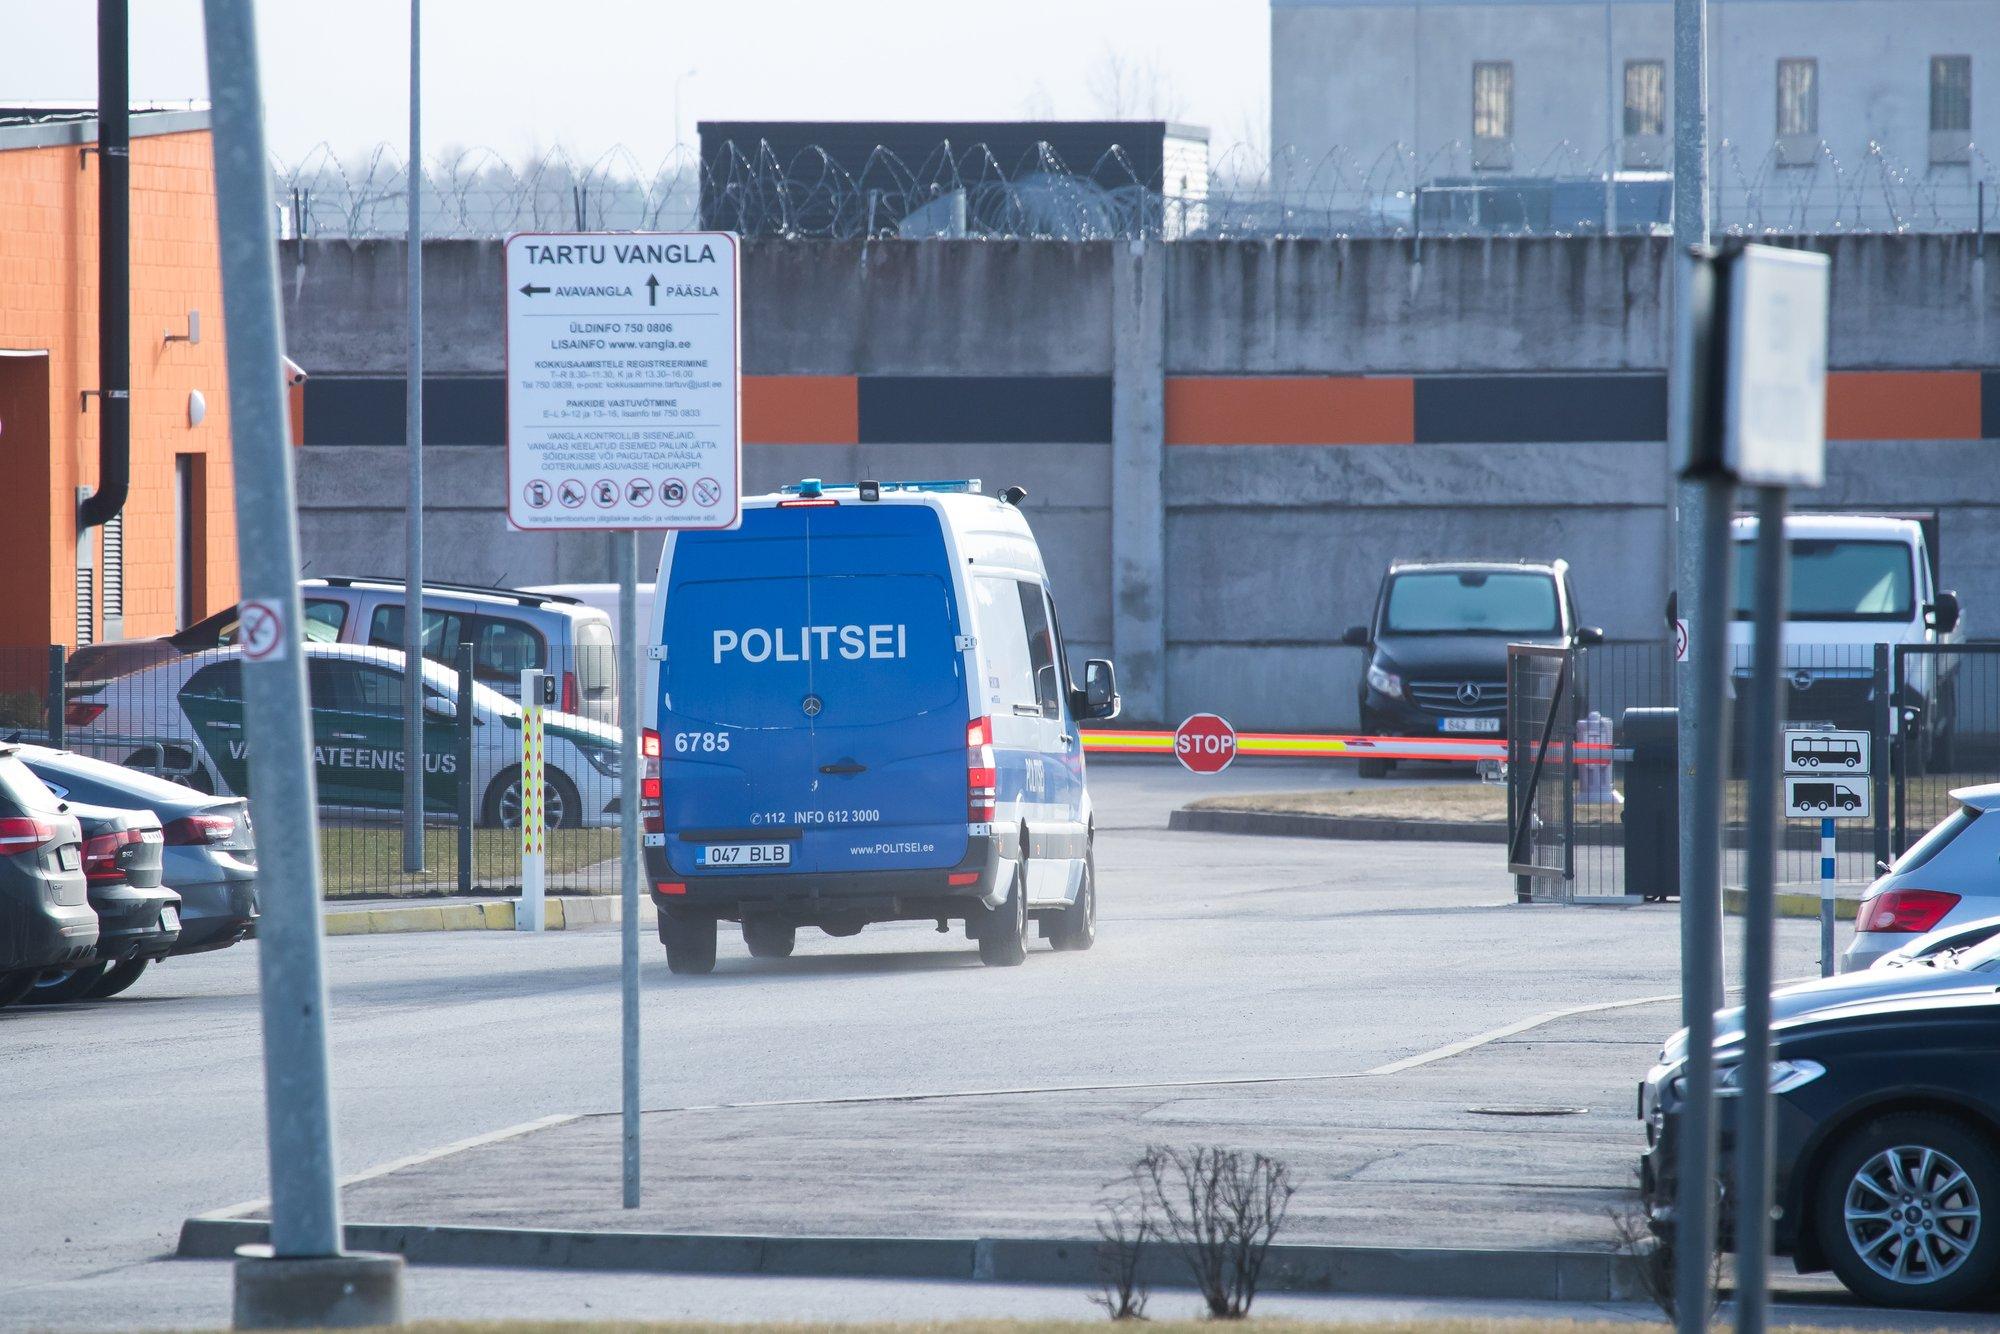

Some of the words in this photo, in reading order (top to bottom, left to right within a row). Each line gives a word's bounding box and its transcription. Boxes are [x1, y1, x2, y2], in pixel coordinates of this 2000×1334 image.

[525, 244, 605, 264] TARTU
[614, 243, 716, 264] VANGLA
[555, 286, 633, 297] AVAVANGLA
[666, 284, 719, 297] PÄÄSLA
[569, 321, 621, 333] ÜLDINFO
[624, 323, 644, 333] 750
[646, 322, 673, 333] 0806
[551, 339, 606, 350] LISAINFO
[608, 340, 691, 351] www.vangla.ee
[534, 360, 623, 369] KOKKUSAAMISTELE
[626, 359, 708, 368] REGISTREERIMINE
[566, 399, 605, 408] PAKKIDE
[607, 398, 678, 408] VASTUVÕTMINE
[546, 431, 583, 440] VANGLA
[583, 431, 641, 440] KONTROLLIB
[527, 441, 569, 451] VANGLAS
[570, 441, 617, 450] KEELATUD
[618, 441, 657, 450] ESEMED
[659, 441, 688, 450] PALUN
[615, 451, 666, 460] PAIGUTADA
[602, 462, 651, 471] ASUVASSE
[713, 624, 906, 664] POLITSEI
[674, 732, 730, 753] 6785
[1178, 734, 1232, 754] STOP
[229, 740, 457, 774] VATEENISUS
[764, 812, 786, 824] 112
[794, 811, 824, 824] INFO
[827, 810, 849, 823] 612
[852, 809, 880, 823] 3000
[712, 847, 740, 863] 047
[750, 846, 785, 862] BLB
[850, 842, 935, 856] www.POLITSEI.ee
